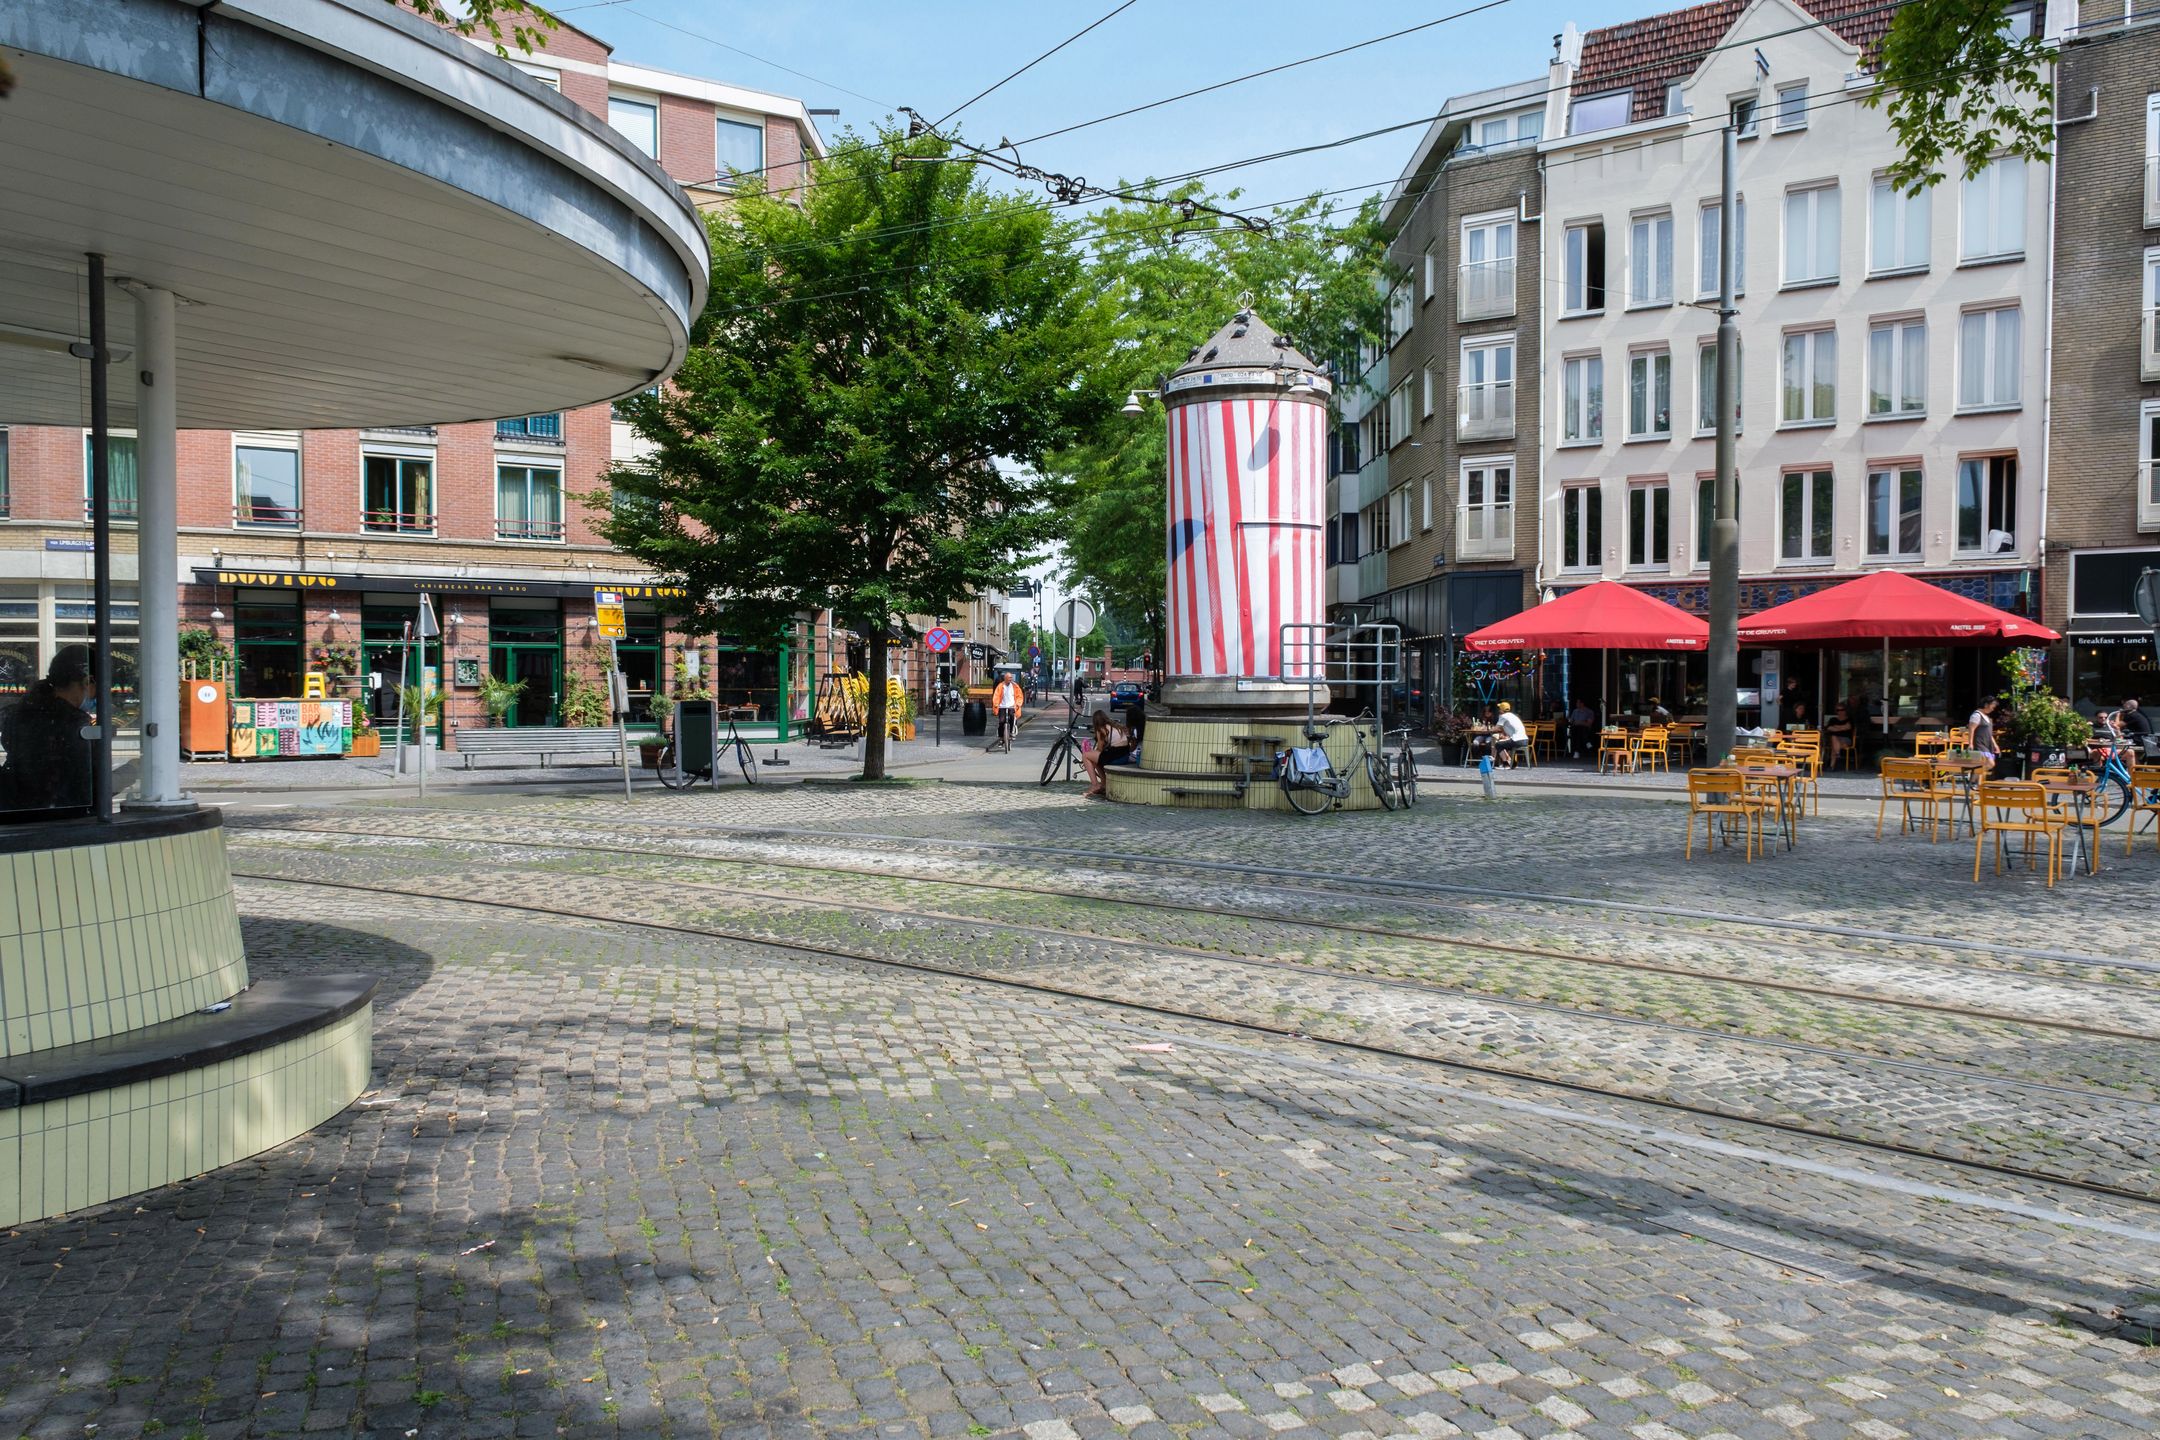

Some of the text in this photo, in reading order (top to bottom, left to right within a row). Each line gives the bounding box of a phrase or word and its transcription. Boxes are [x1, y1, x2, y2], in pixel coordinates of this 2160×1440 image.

[2078, 636, 2148, 645] Breakfast Lunch
[2129, 660, 2160, 672] Coff
[302, 703, 321, 714] BAR
